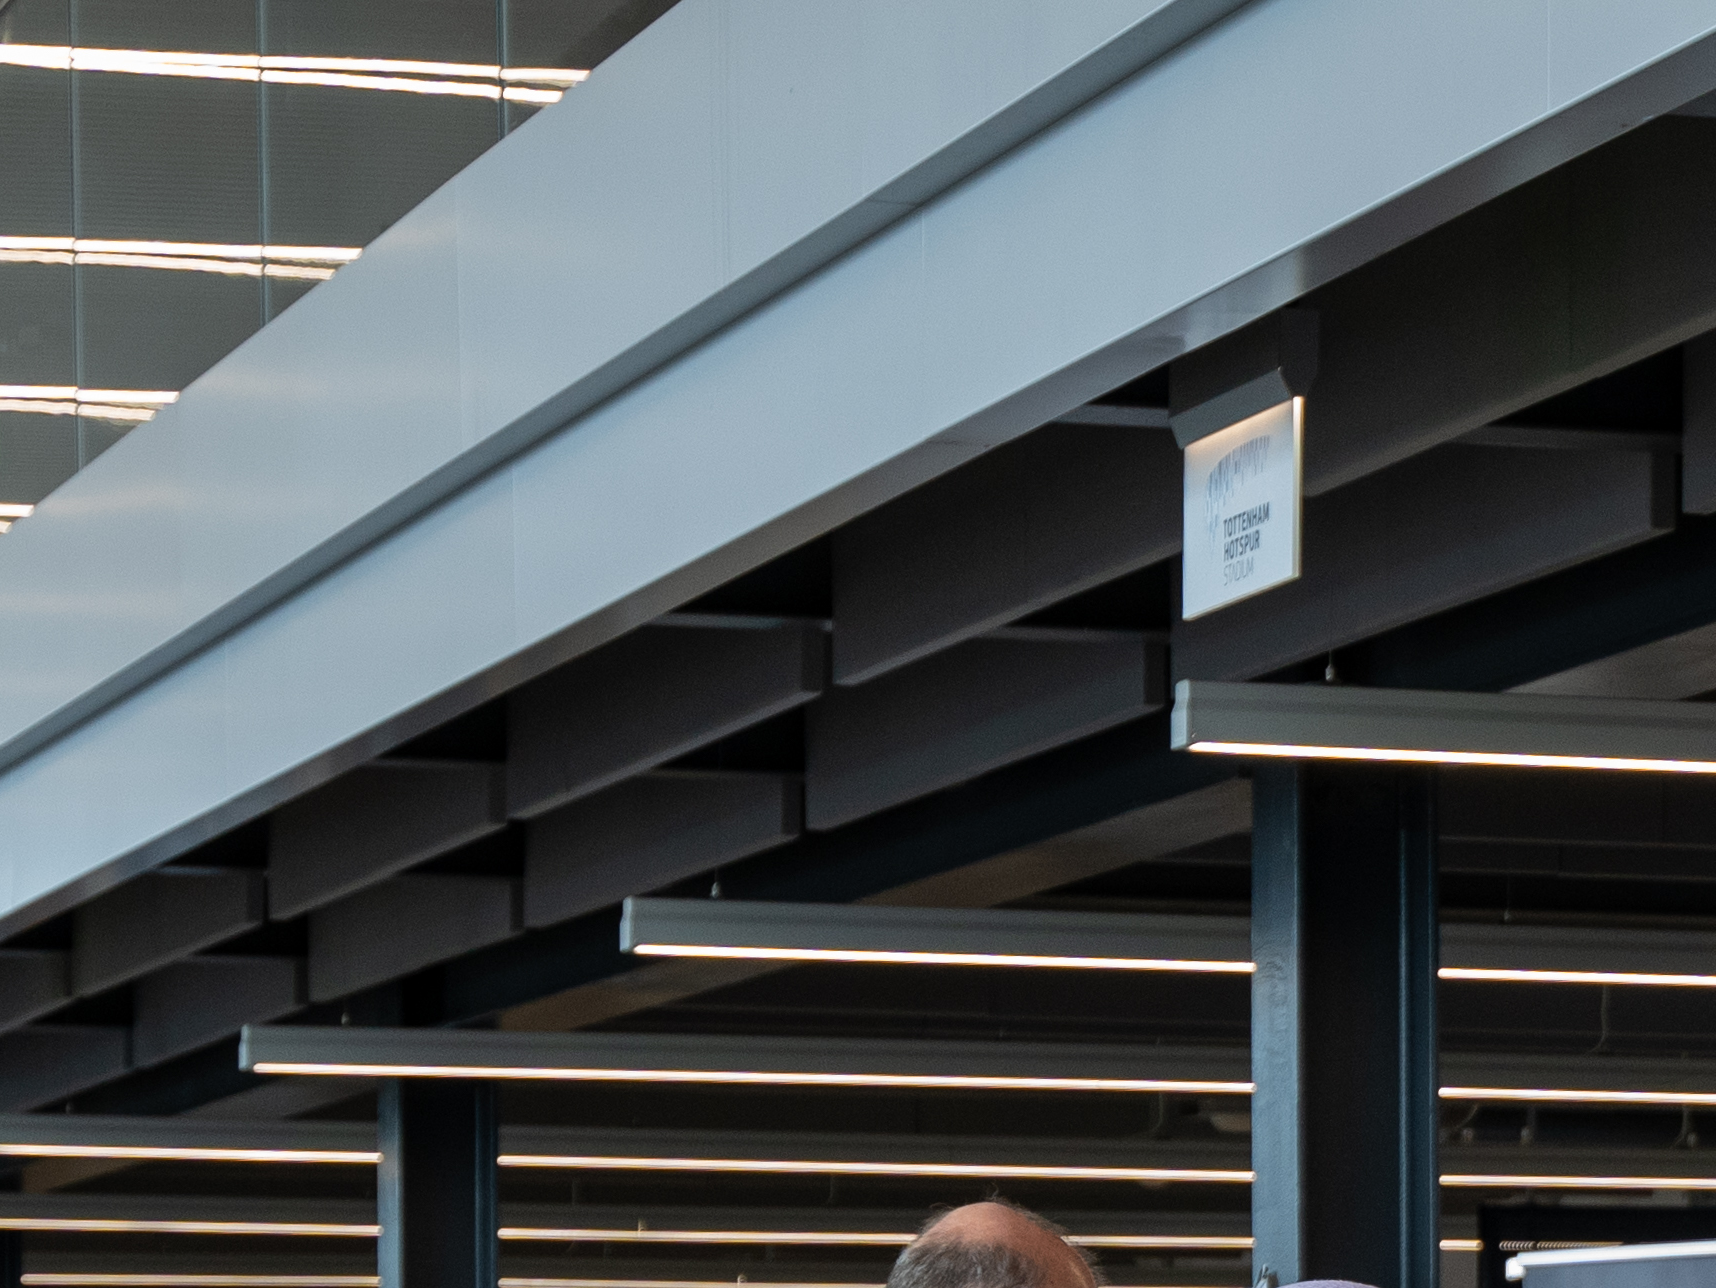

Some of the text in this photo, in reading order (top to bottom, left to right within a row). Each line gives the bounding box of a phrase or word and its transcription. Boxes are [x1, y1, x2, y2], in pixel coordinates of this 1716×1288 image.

[1223, 501, 1270, 538] TOTTENHAM
[1223, 529, 1260, 562] HOTSPUR
[1223, 556, 1254, 586] STADIUM
